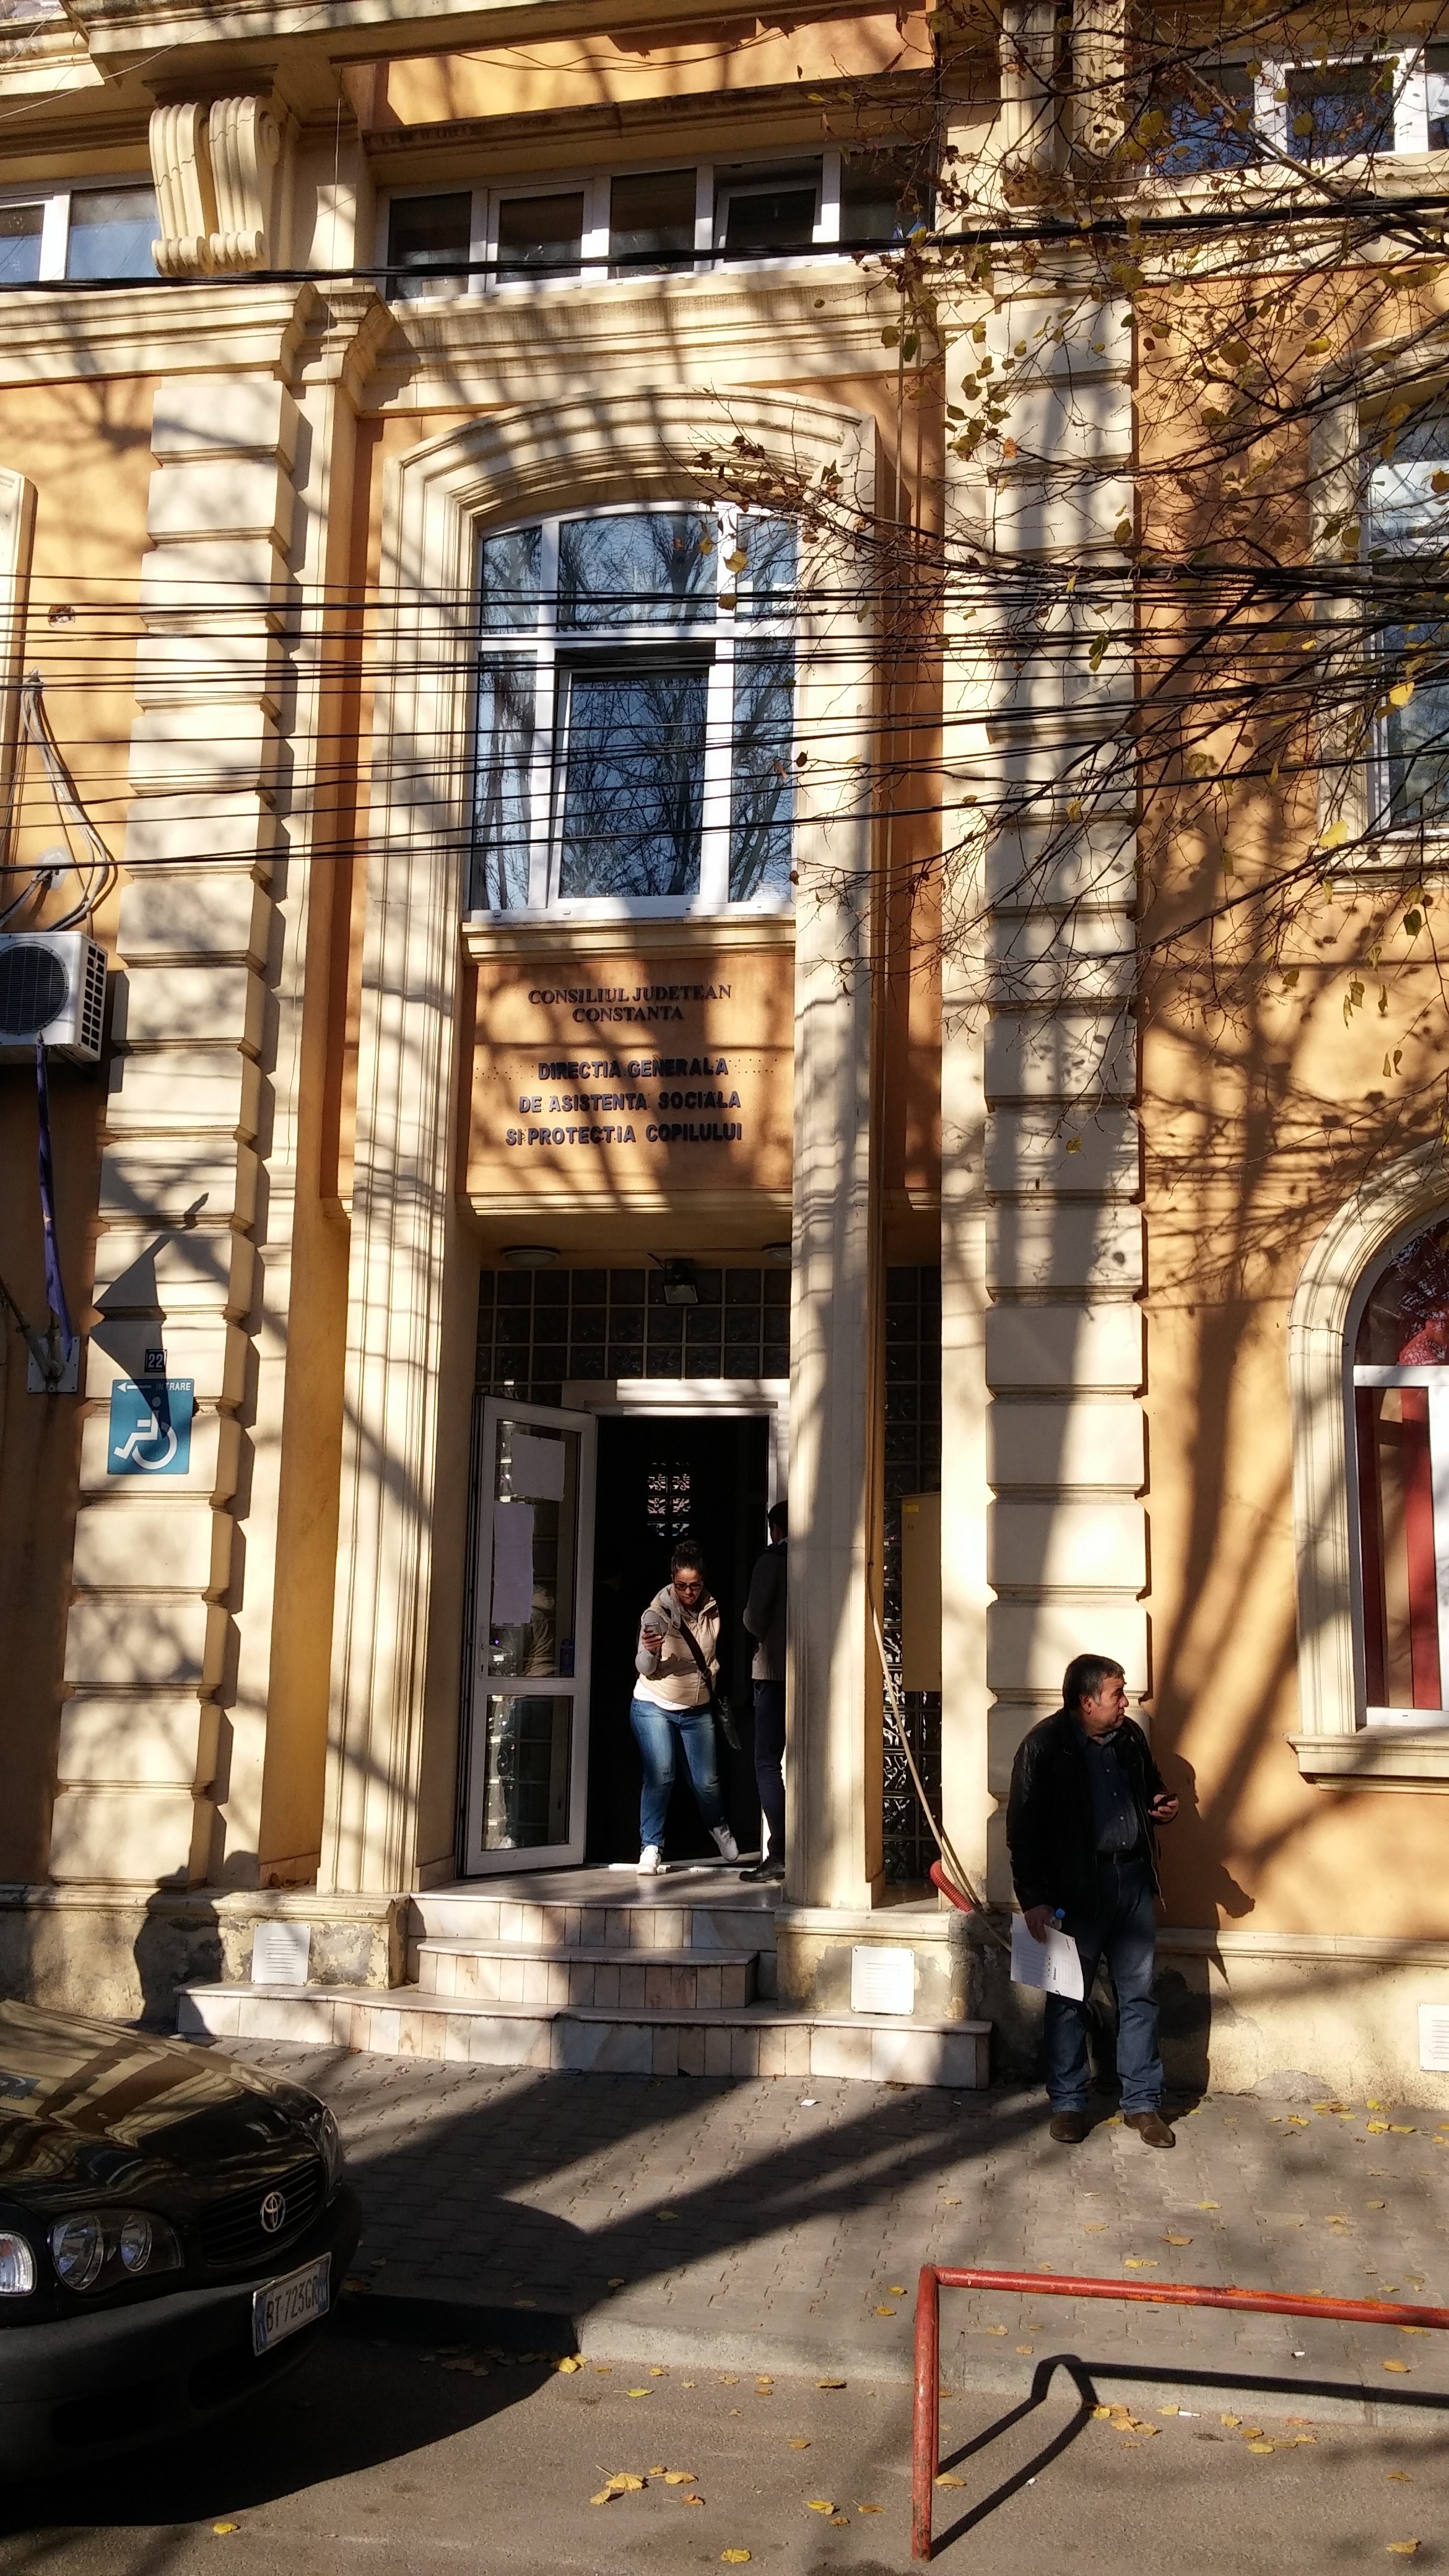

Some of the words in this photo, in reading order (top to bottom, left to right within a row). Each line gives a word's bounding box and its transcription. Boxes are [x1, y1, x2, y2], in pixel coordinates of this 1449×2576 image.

[528, 986, 630, 1005] CONSILIUL
[632, 983, 732, 1003] JUDETEAN
[572, 1005, 684, 1023] CONSTANTA
[537, 1060, 620, 1080] DIRECTIA
[627, 1057, 728, 1079] GENERALA
[519, 1095, 542, 1113] DE
[548, 1092, 648, 1112] ASISTENTA
[657, 1090, 741, 1110] SOCIALA
[505, 1128, 523, 1146] SI
[527, 1125, 637, 1145] PROTECTIA
[646, 1121, 742, 1142] COPILULUI
[147, 1353, 163, 1368] 22
[155, 1382, 191, 1391] INTRARE
[266, 2295, 281, 2333] BT
